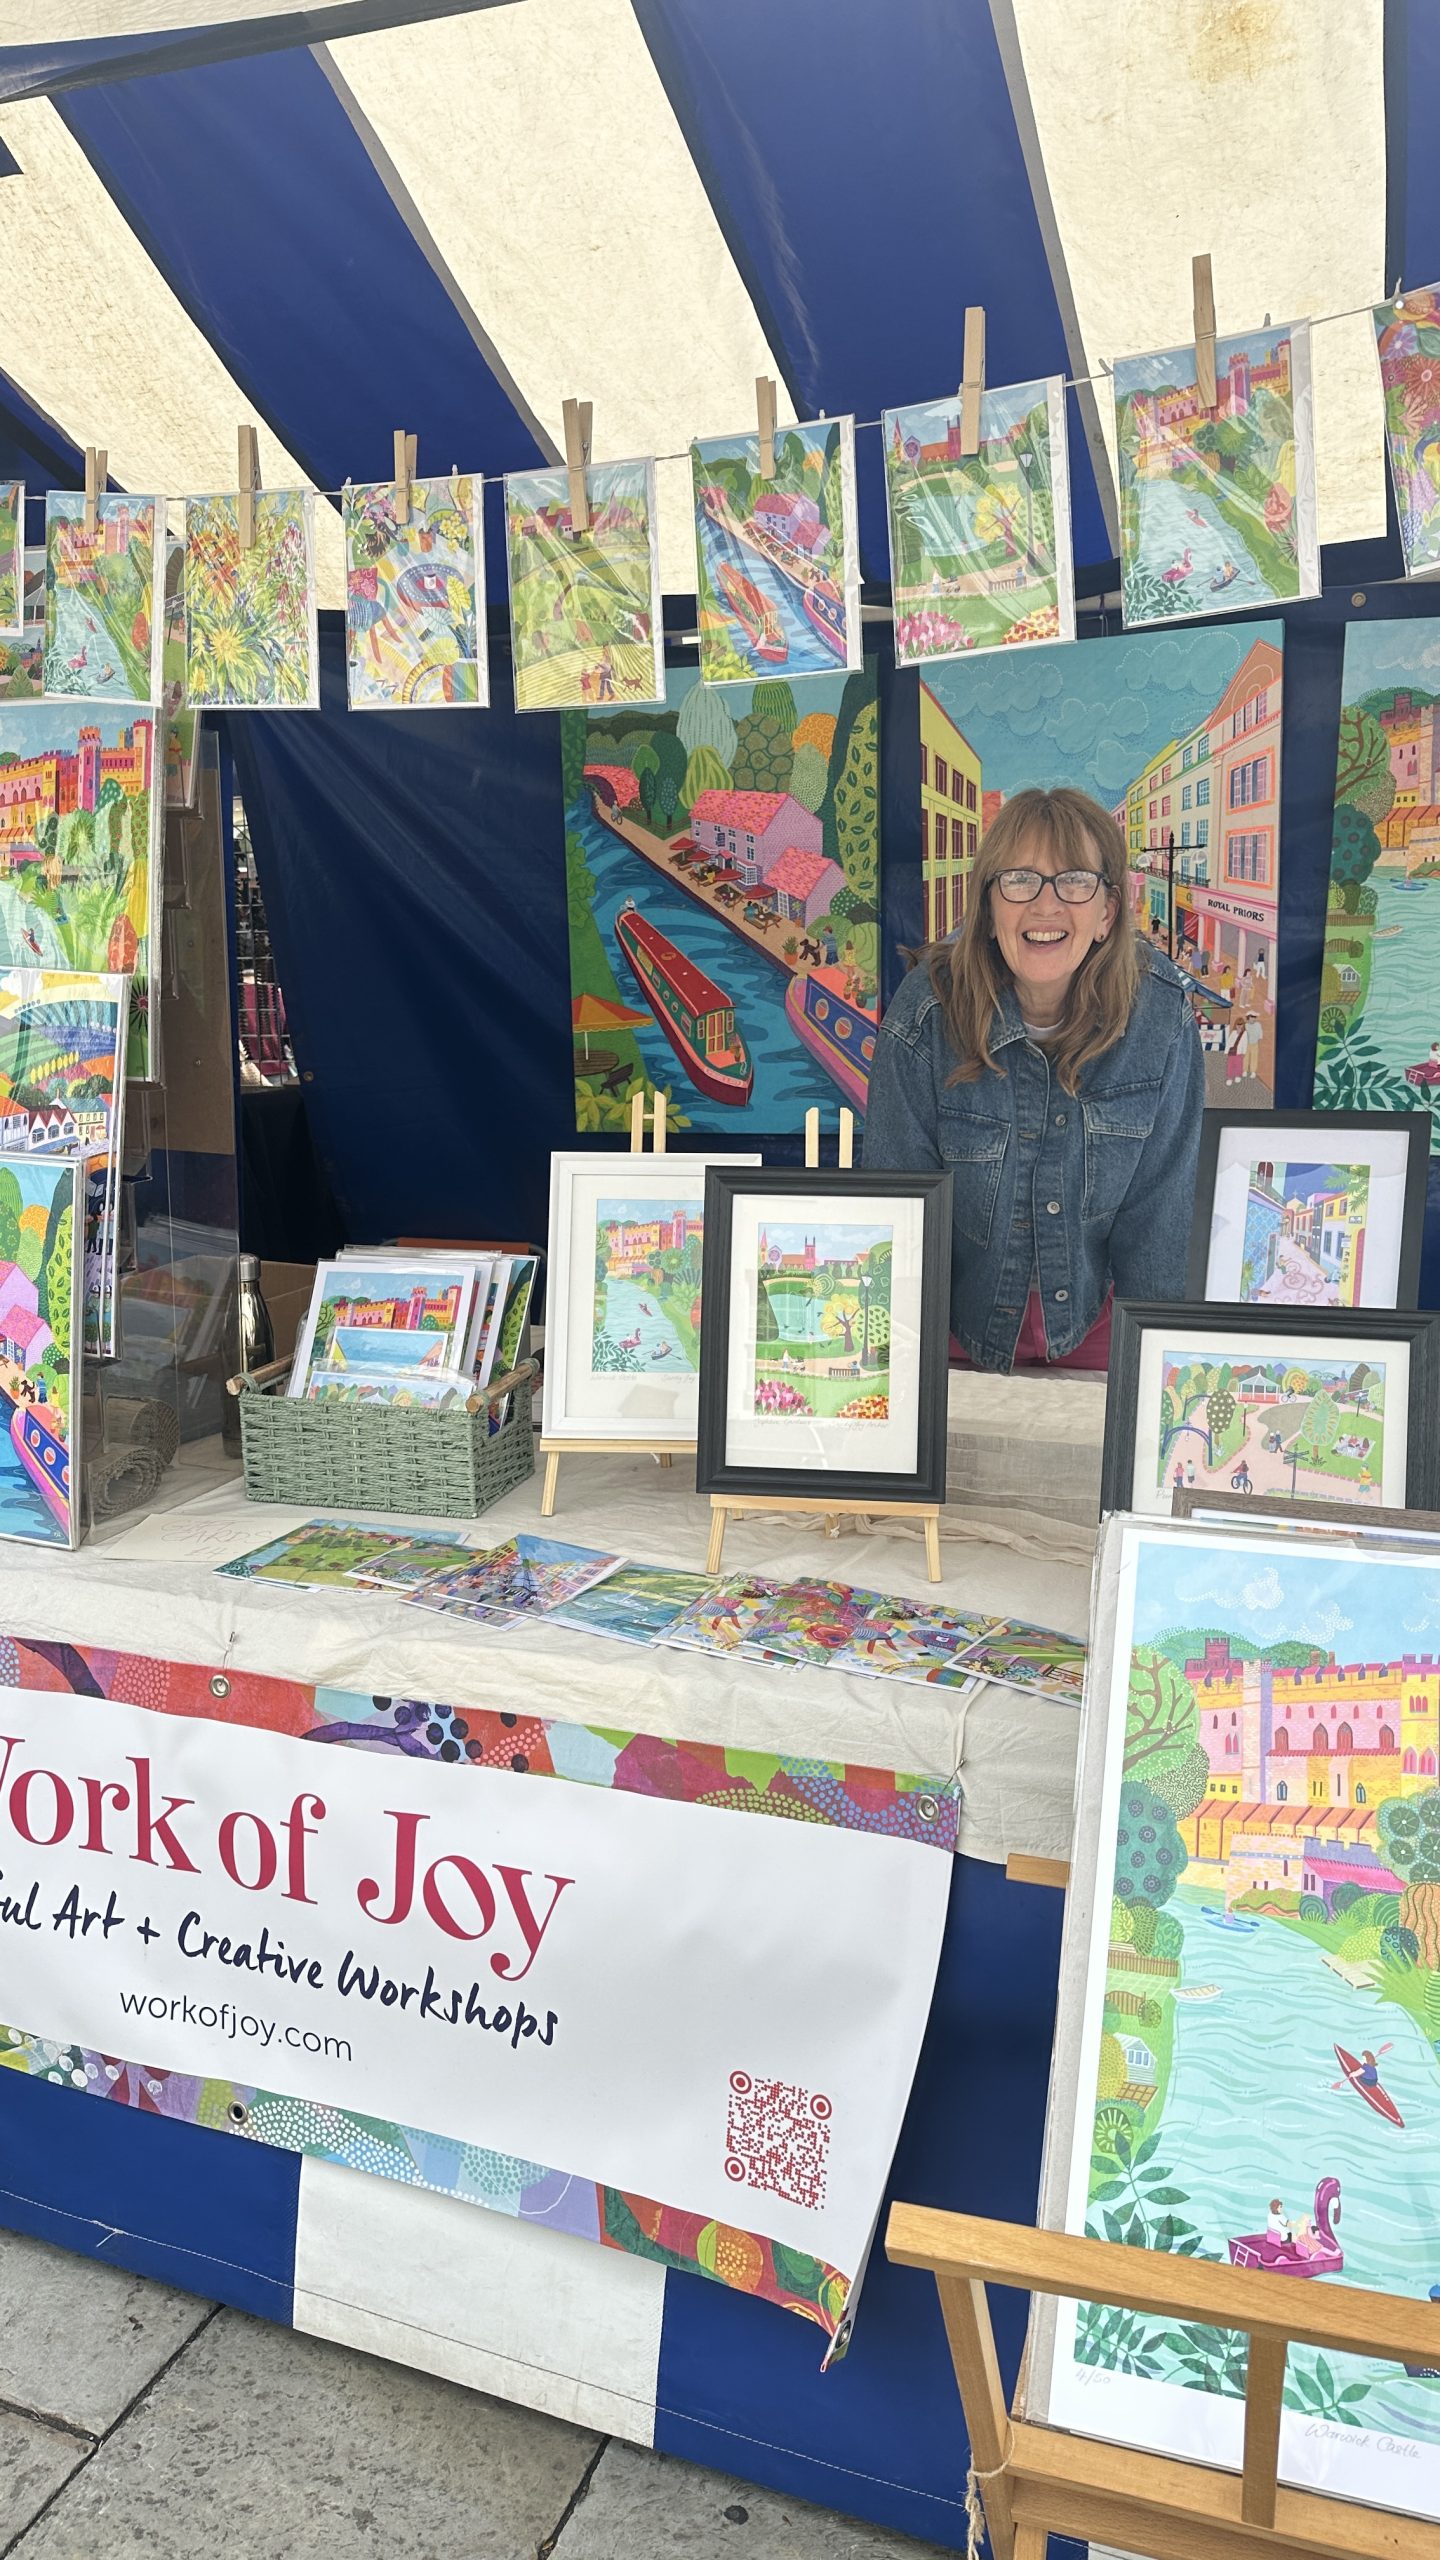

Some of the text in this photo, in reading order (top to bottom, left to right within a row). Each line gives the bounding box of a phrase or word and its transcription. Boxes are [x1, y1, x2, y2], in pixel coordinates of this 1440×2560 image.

[1208, 899, 1264, 922] ROYAL PRIORS
[0, 1735, 576, 1982] ork of Joy
[0, 1870, 559, 2050] ul Art + Creative Workshops
[119, 1990, 353, 2062] workofjoy.com
[1304, 2423, 1421, 2459] Warwick Castle
